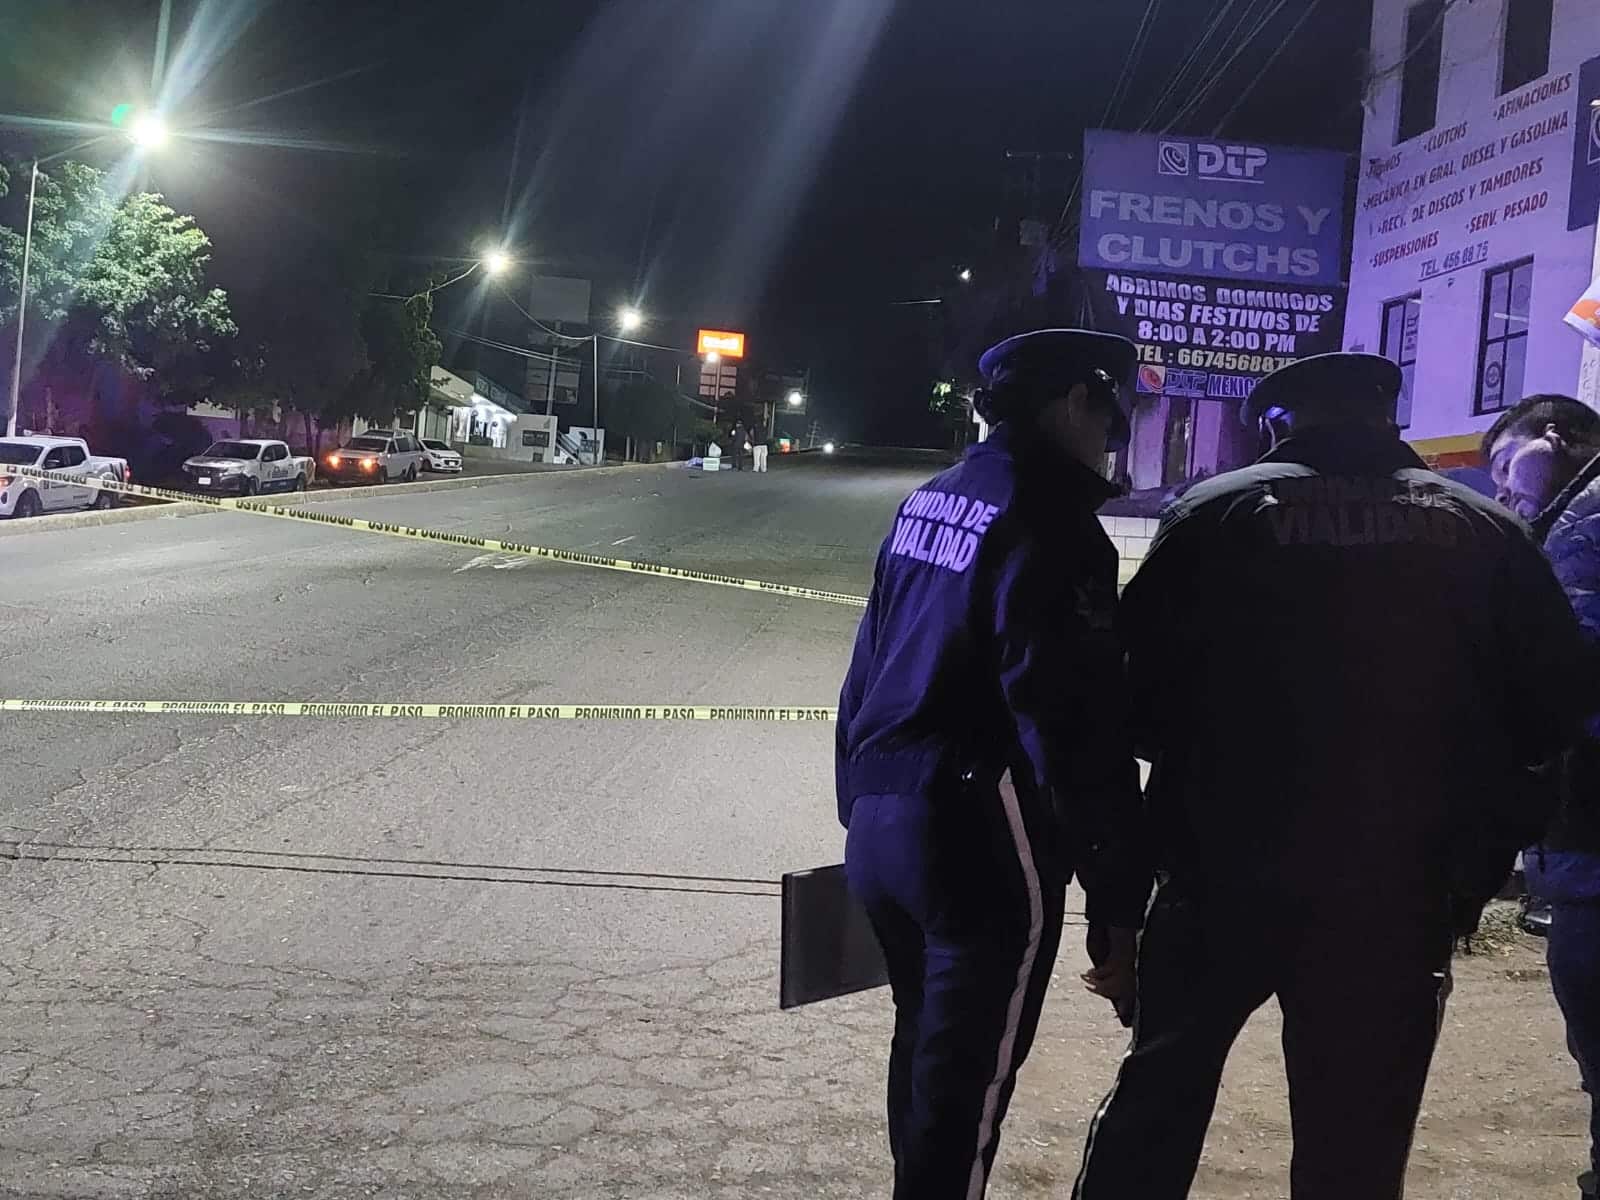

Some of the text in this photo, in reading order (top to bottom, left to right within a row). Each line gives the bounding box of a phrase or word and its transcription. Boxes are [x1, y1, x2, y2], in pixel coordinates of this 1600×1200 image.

[1500, 136, 1509, 154] Y
[1510, 111, 1569, 149] GASOLINA
[1427, 188, 1465, 216] DISCOS
[1468, 184, 1476, 200] Y
[1480, 157, 1543, 194] TAMBORES
[1503, 191, 1548, 221] PESADO
[1090, 189, 1331, 236] FRENOS Y
[1097, 232, 1321, 277] CLUTCHS
[1372, 231, 1440, 268] SUSPENSIONES
[1106, 274, 1333, 312] ABRIMOS DOMINGOS
[1116, 295, 1321, 333] Y DIAS FESTIVOS DE
[1138, 320, 1296, 353] 8:00 A 2:00 PM
[902, 490, 1000, 535] UNIDAD DE
[890, 516, 978, 573] VIALIDAD
